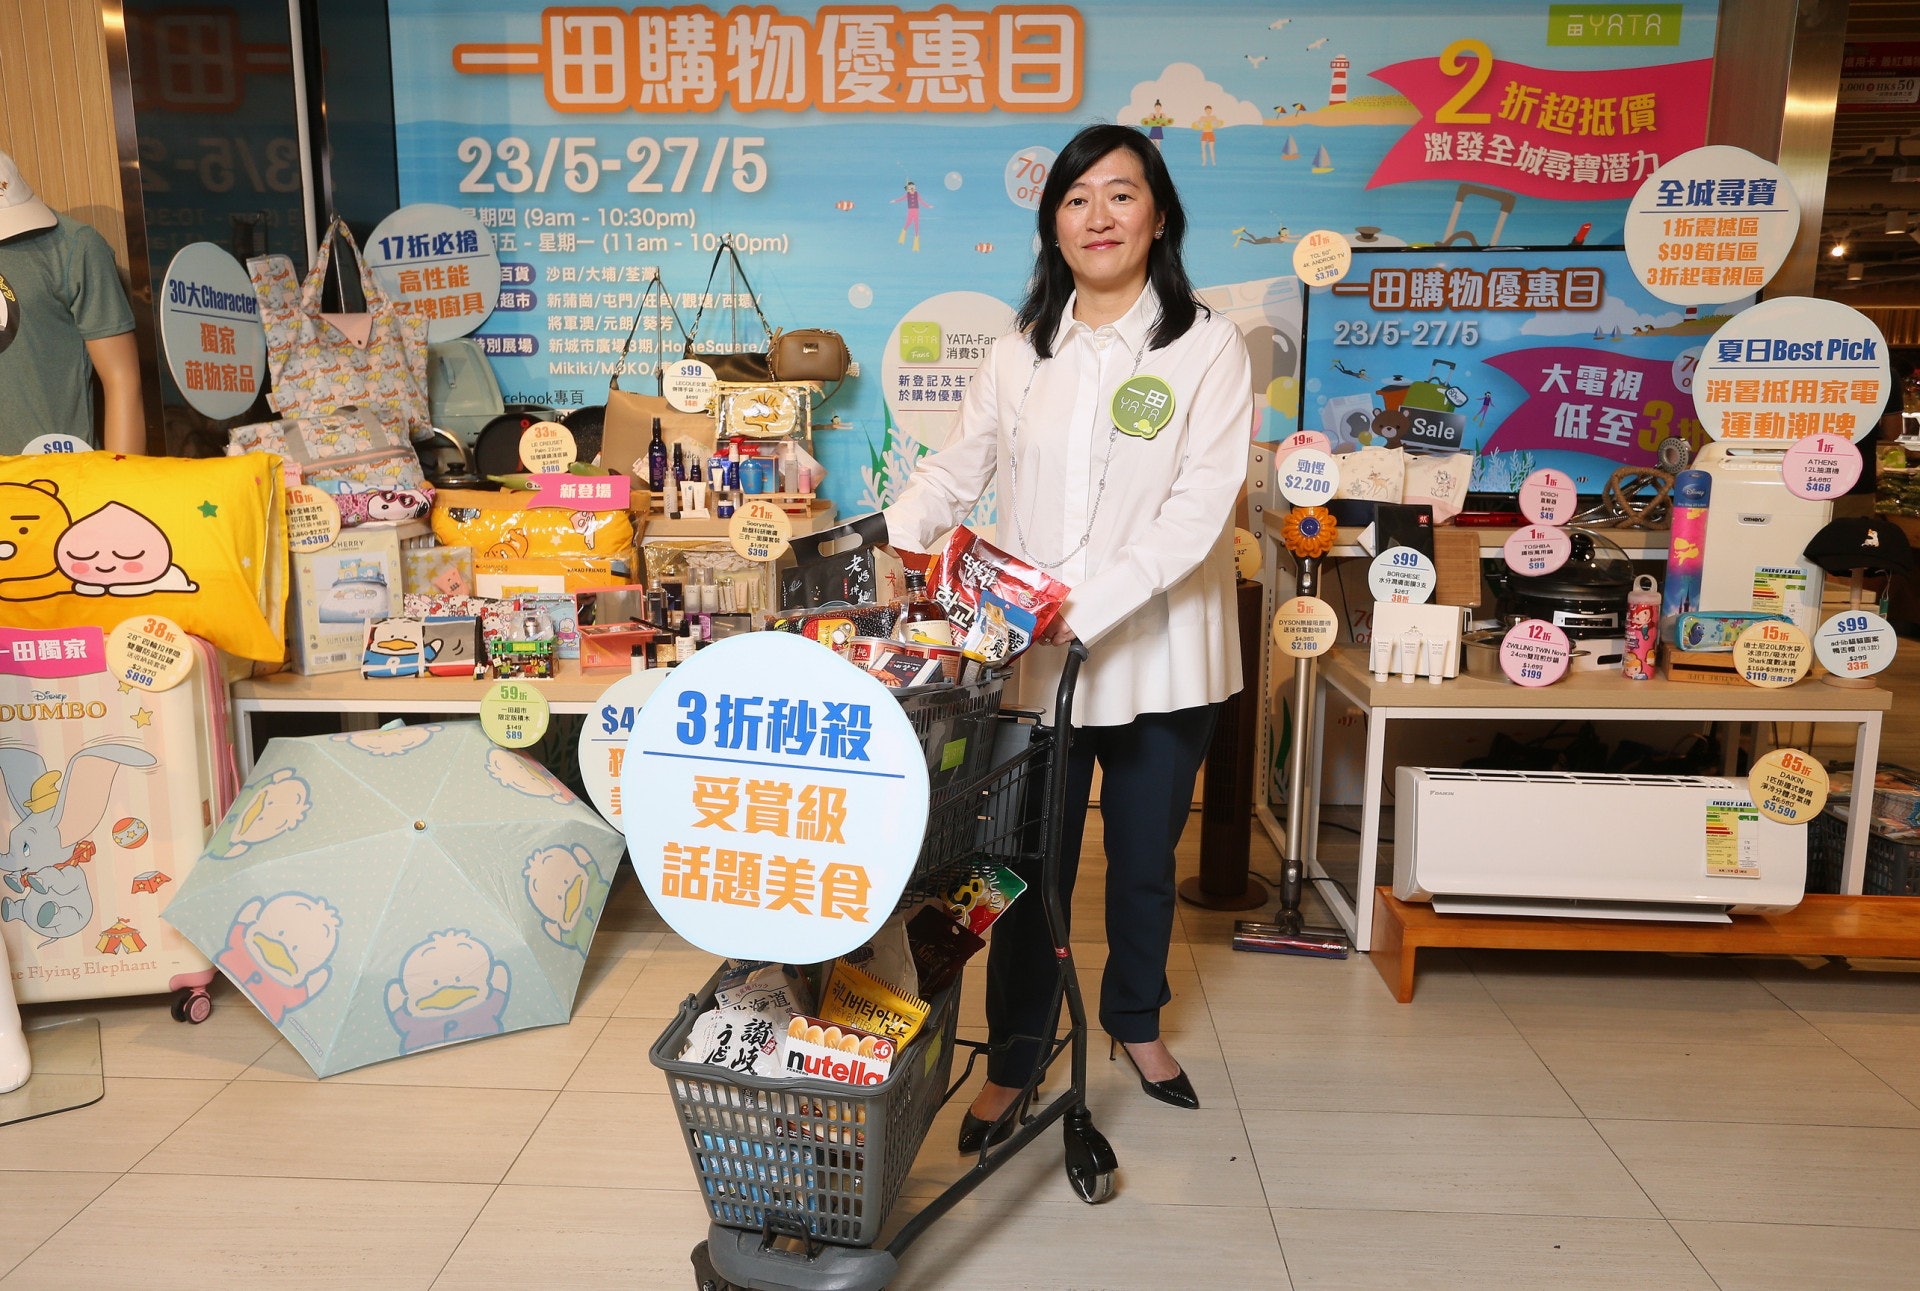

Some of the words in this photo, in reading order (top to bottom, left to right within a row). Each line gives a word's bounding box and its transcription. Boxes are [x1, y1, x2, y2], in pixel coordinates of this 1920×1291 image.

[1590, 14, 1662, 37] YATA
[458, 11, 1078, 105] 一田購物優惠日
[457, 136, 768, 193] 23/5-27/5
[1424, 131, 1660, 185] 激發全城尋寶潛力
[1656, 178, 1778, 207] 全城尋寶
[524, 208, 574, 229] (9am
[598, 208, 696, 229] 10:30pm)
[1662, 217, 1760, 238] 1折震撼區
[378, 229, 479, 261] 17折必搶
[538, 233, 595, 252] 星期一
[602, 233, 668, 253] (11am
[397, 264, 471, 295] 高性能
[546, 266, 656, 283] 沙田/大埔/荃灣
[1647, 266, 1765, 287] 3折起電視區
[1334, 270, 1600, 309] 一田購物優惠日
[547, 316, 674, 331] 將軍澳/元朗/葵芳
[1333, 320, 1480, 346] 23/5-27/5
[200, 322, 237, 355] 獨家
[1827, 338, 1877, 362] Pick
[185, 360, 256, 394] 萌物家品
[681, 365, 702, 376] $99
[898, 374, 973, 387] 新登記及生
[1540, 363, 1644, 401] 大電視
[1705, 379, 1880, 405] 消暑抵用家電
[898, 389, 963, 402] 於購物優惠
[1120, 396, 1160, 422] YATA
[1412, 418, 1455, 440] Sale
[1720, 410, 1857, 440] 運動潮牌
[1816, 438, 1834, 453] 1折
[560, 483, 611, 499] 新登場
[1285, 474, 1331, 493] $2,200
[1806, 482, 1831, 492] $468
[1540, 512, 1553, 520] $49
[747, 548, 768, 557] $398
[1393, 552, 1418, 566] $99
[1387, 571, 1421, 580] BORGHESE
[1528, 625, 1551, 641] 12折
[1762, 625, 1789, 642] 15折
[1837, 616, 1868, 634] $99
[1291, 642, 1317, 650] $2,180
[1535, 646, 1551, 654] TWIN
[1521, 669, 1542, 679] $199
[1846, 661, 1869, 671] 33折
[125, 669, 153, 686] $899
[506, 731, 522, 739] $89
[676, 690, 873, 761] 3折秒殺
[1781, 753, 1812, 777] 85折
[1780, 771, 1805, 785] DAIKIN
[691, 775, 848, 844] 受賞級
[1762, 799, 1797, 819] $5,590
[661, 842, 873, 923] 話題美食
[28, 964, 81, 983] Flying
[83, 960, 157, 978] Elephant
[786, 1050, 884, 1086] nutella
